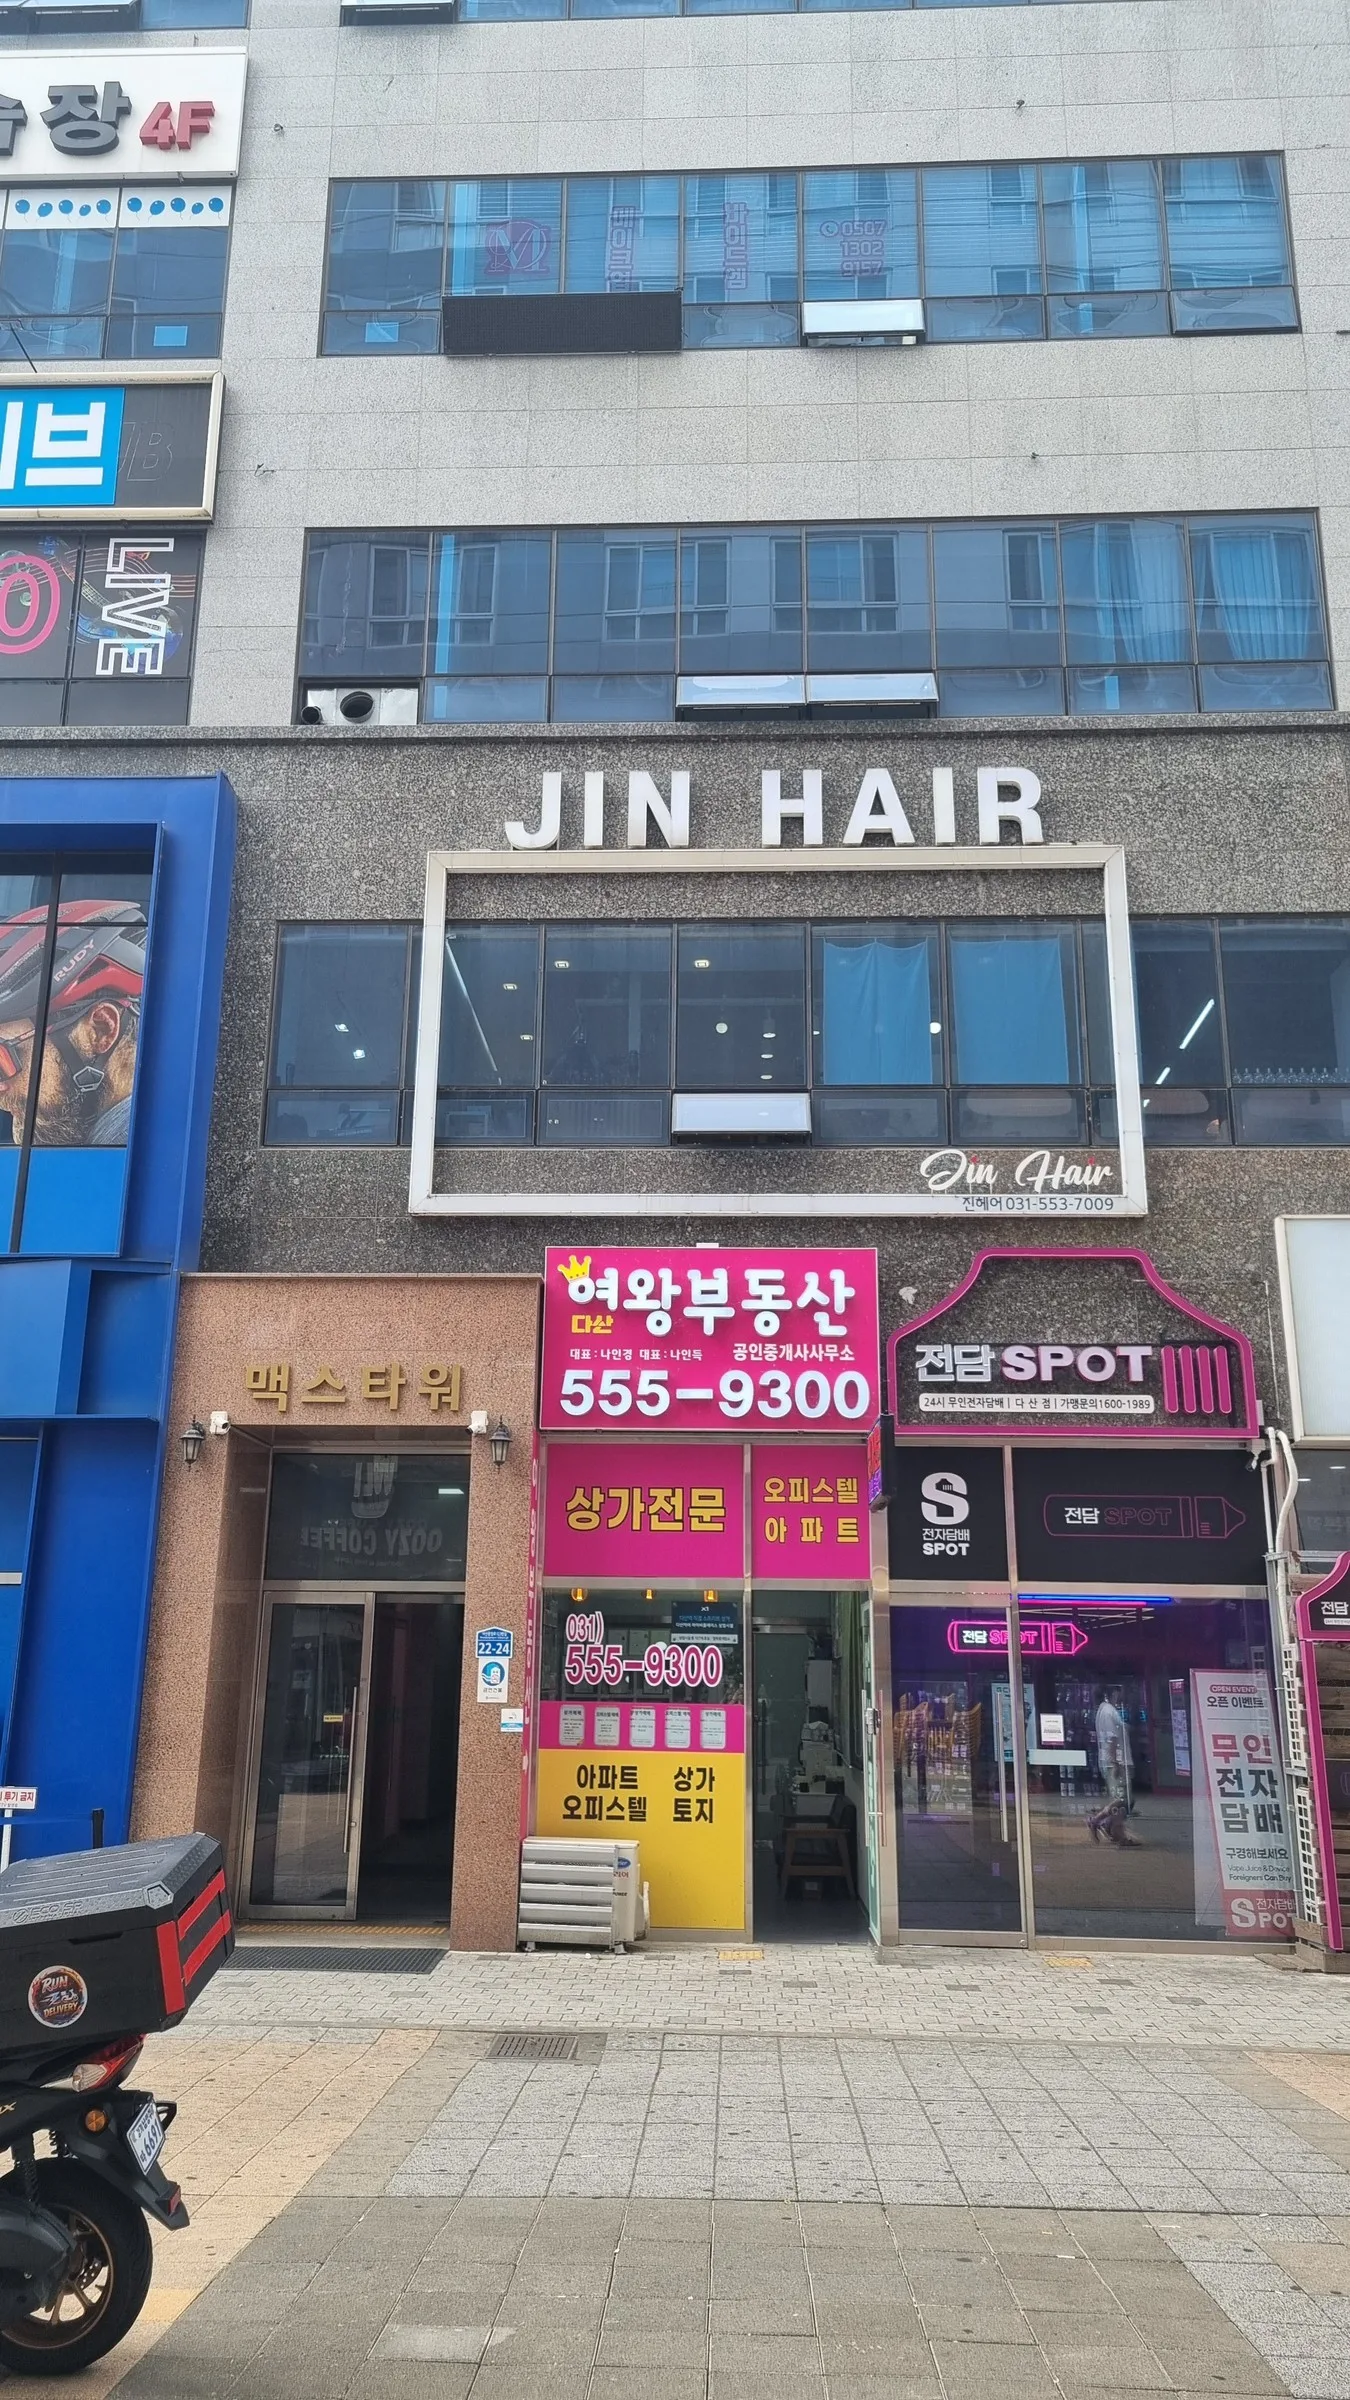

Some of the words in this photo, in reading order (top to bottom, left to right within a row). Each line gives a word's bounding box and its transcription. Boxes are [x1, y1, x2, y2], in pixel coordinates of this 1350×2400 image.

[139, 101, 215, 149] 4F
[842, 221, 885, 236] 0507
[842, 241, 883, 256] 1302
[842, 260, 883, 276] 9157
[95, 538, 175, 676] LIVE
[504, 769, 690, 850] JIN
[761, 766, 1044, 848] HAIR
[53, 938, 95, 982] RUDY
[920, 1149, 998, 1191] Jin
[1015, 1150, 1114, 1193] Hair
[962, 1197, 1001, 1212] 진헤어
[1006, 1197, 1114, 1211] 031-553-7009
[567, 1267, 856, 1337] 여왕부동산
[571, 1314, 614, 1335] 다산
[570, 1349, 591, 1361] 대표
[600, 1348, 633, 1361] 나인경
[639, 1349, 661, 1361] 대표
[670, 1348, 703, 1361] 나인득
[732, 1342, 855, 1362] 공인중개사사무소
[915, 1344, 996, 1382] 전담
[1001, 1345, 1153, 1383] SPOT
[245, 1362, 462, 1412] 맥스타워
[560, 1369, 871, 1419] 555-9300
[924, 1397, 945, 1408] 24시
[948, 1397, 1004, 1410] 무인전자담배
[764, 1477, 859, 1504] 오피스텔
[565, 1486, 727, 1533] 상가전문
[1064, 1507, 1100, 1525] 전담
[1103, 1507, 1173, 1526] SPOT
[922, 1528, 971, 1541] 전자담배
[922, 1542, 971, 1556] SPOT
[1320, 1601, 1349, 1616] 전담
[565, 1611, 605, 1646] 031)
[962, 1630, 988, 1644] 전담
[478, 1642, 510, 1656] 22-24
[564, 1644, 723, 1688] 555-9300
[1206, 1695, 1229, 1708] 오픈
[1231, 1696, 1265, 1709] 이벤트
[1211, 1734, 1273, 1764] 무인
[576, 1765, 638, 1790] 아파트
[673, 1767, 715, 1792] 상가
[1215, 1768, 1278, 1799] 전자
[5, 1791, 19, 1802] 투기
[20, 1791, 34, 1803] 금지
[562, 1795, 647, 1822] 오피스텔
[673, 1798, 714, 1824] 토지
[1220, 1803, 1284, 1833] 담배
[1226, 1847, 1289, 1860] 구경해보세요
[1229, 1873, 1263, 1882] Foreigners
[41, 1975, 69, 1993] RUN
[43, 2001, 79, 2018] DELIVERY
